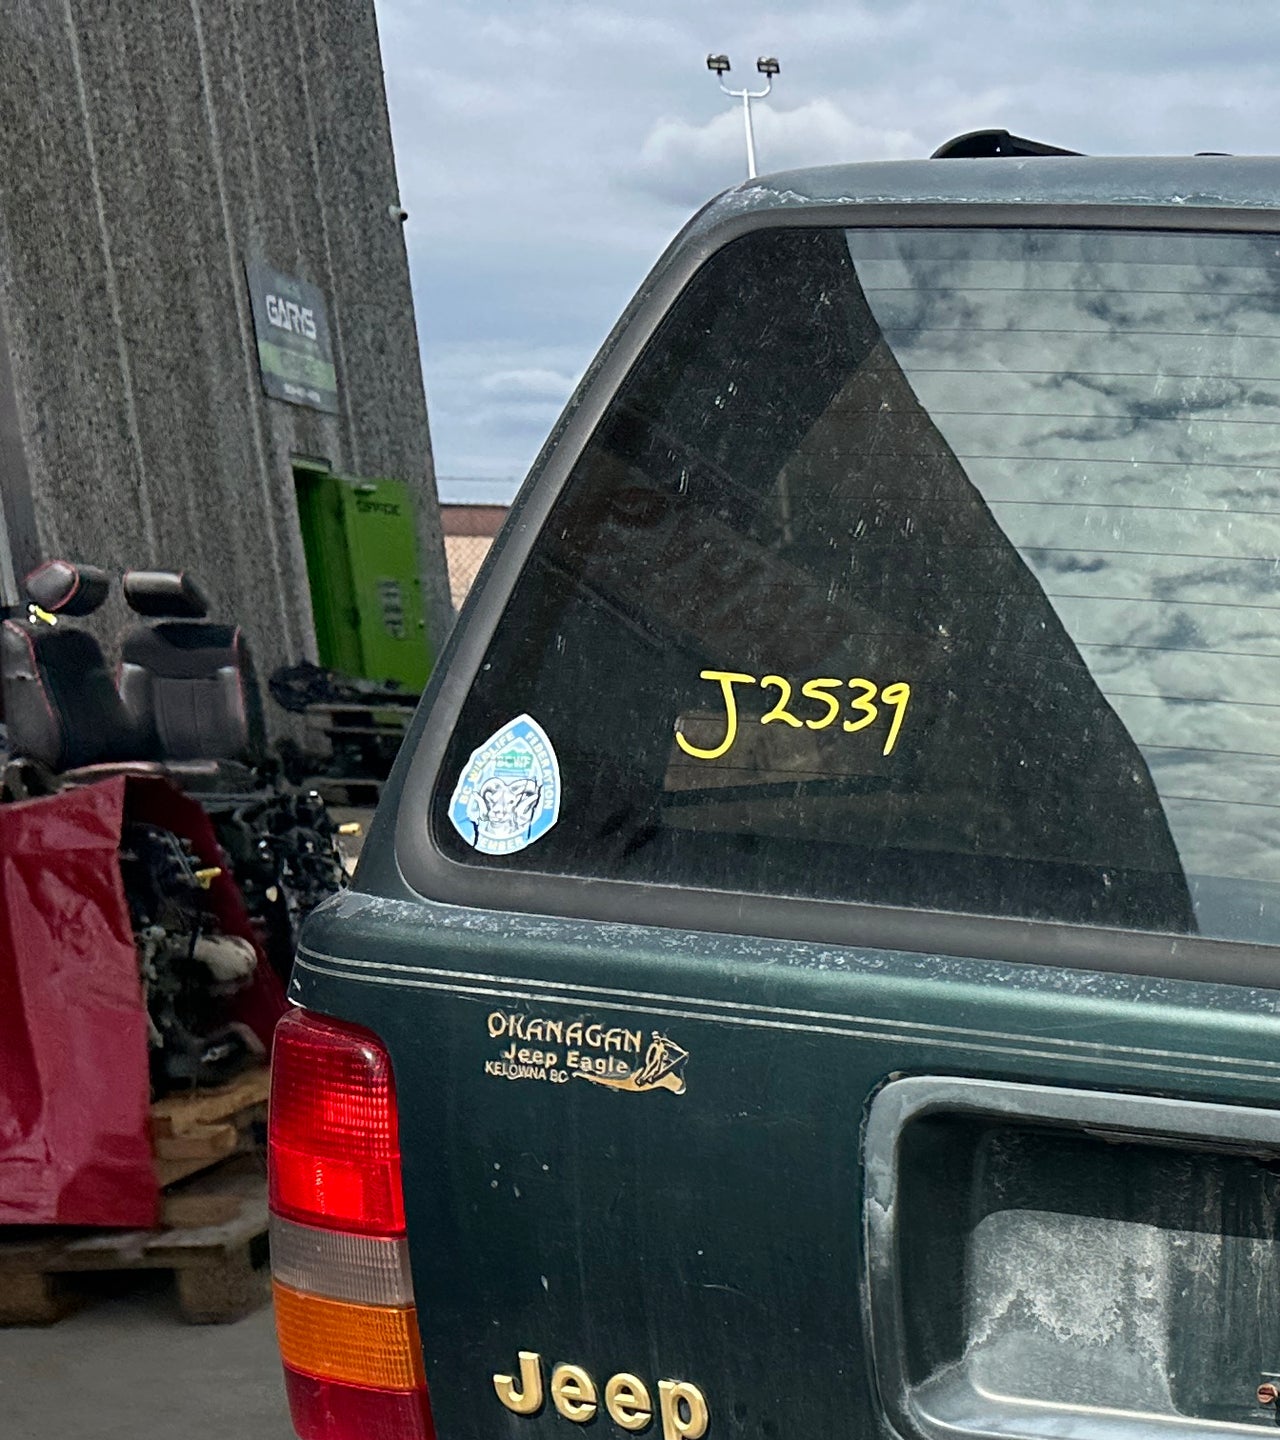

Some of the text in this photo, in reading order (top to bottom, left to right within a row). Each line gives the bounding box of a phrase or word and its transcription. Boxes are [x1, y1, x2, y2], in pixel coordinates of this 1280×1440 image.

[675, 670, 910, 759] J2539
[460, 731, 555, 810] BC WILDLIFE FEDERATION
[487, 1012, 642, 1053] OKANAGAN
[485, 1060, 569, 1084] KELOWNA BC
[504, 1043, 630, 1075] Jeep Eagle
